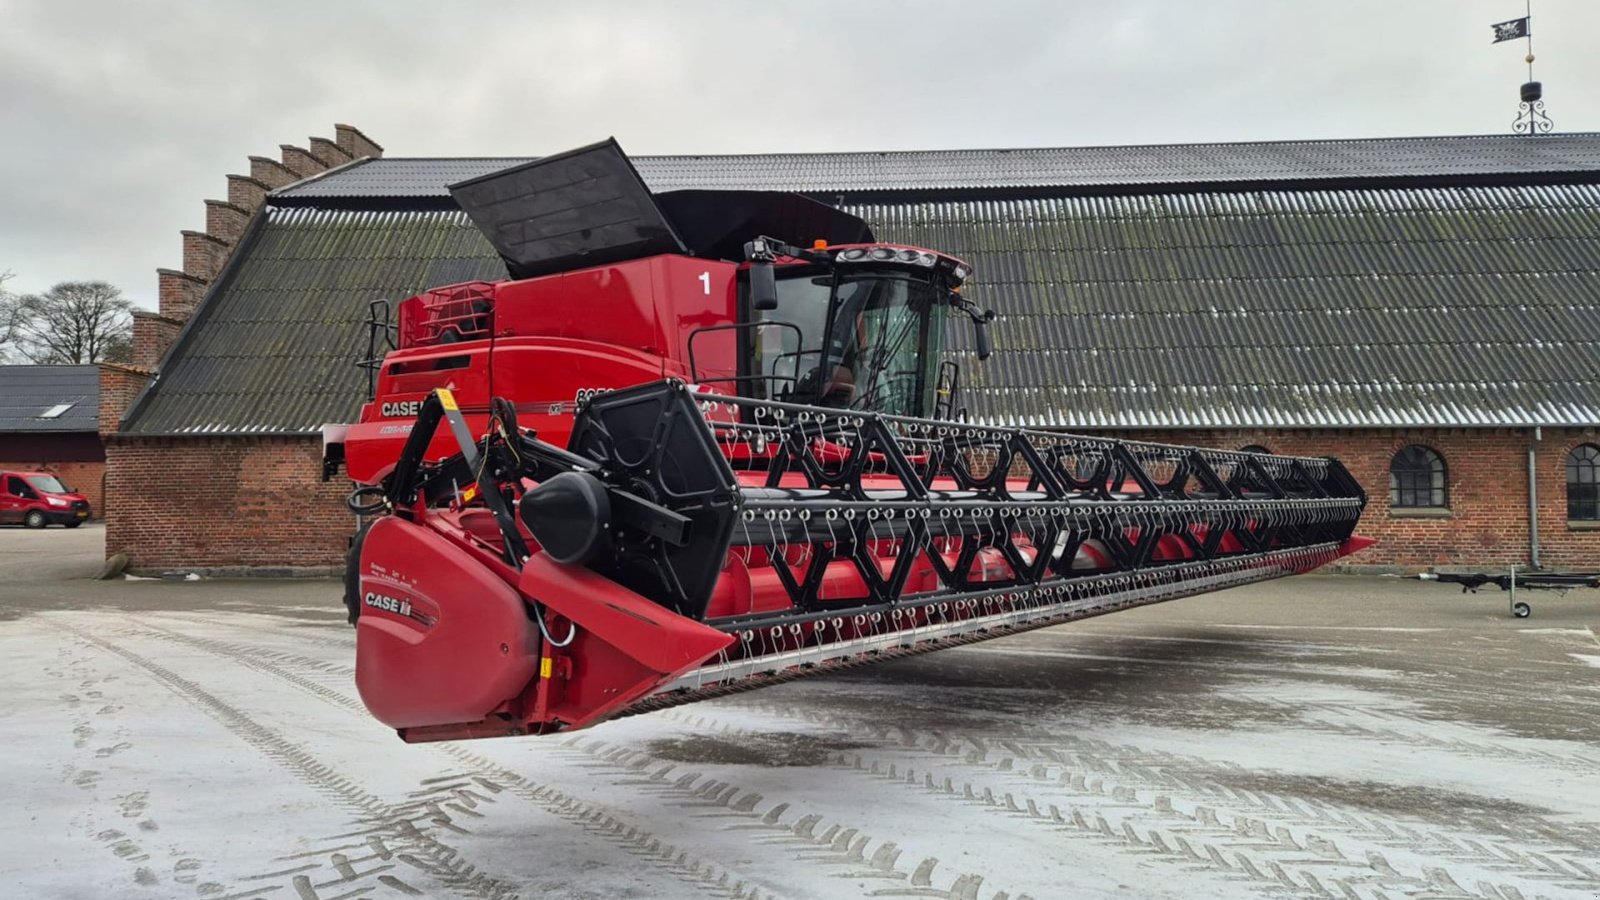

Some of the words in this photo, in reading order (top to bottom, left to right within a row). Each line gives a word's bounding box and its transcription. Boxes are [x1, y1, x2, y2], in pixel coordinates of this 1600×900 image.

[698, 271, 710, 295] 1
[381, 401, 418, 417] CASE
[365, 592, 399, 612] CASE
